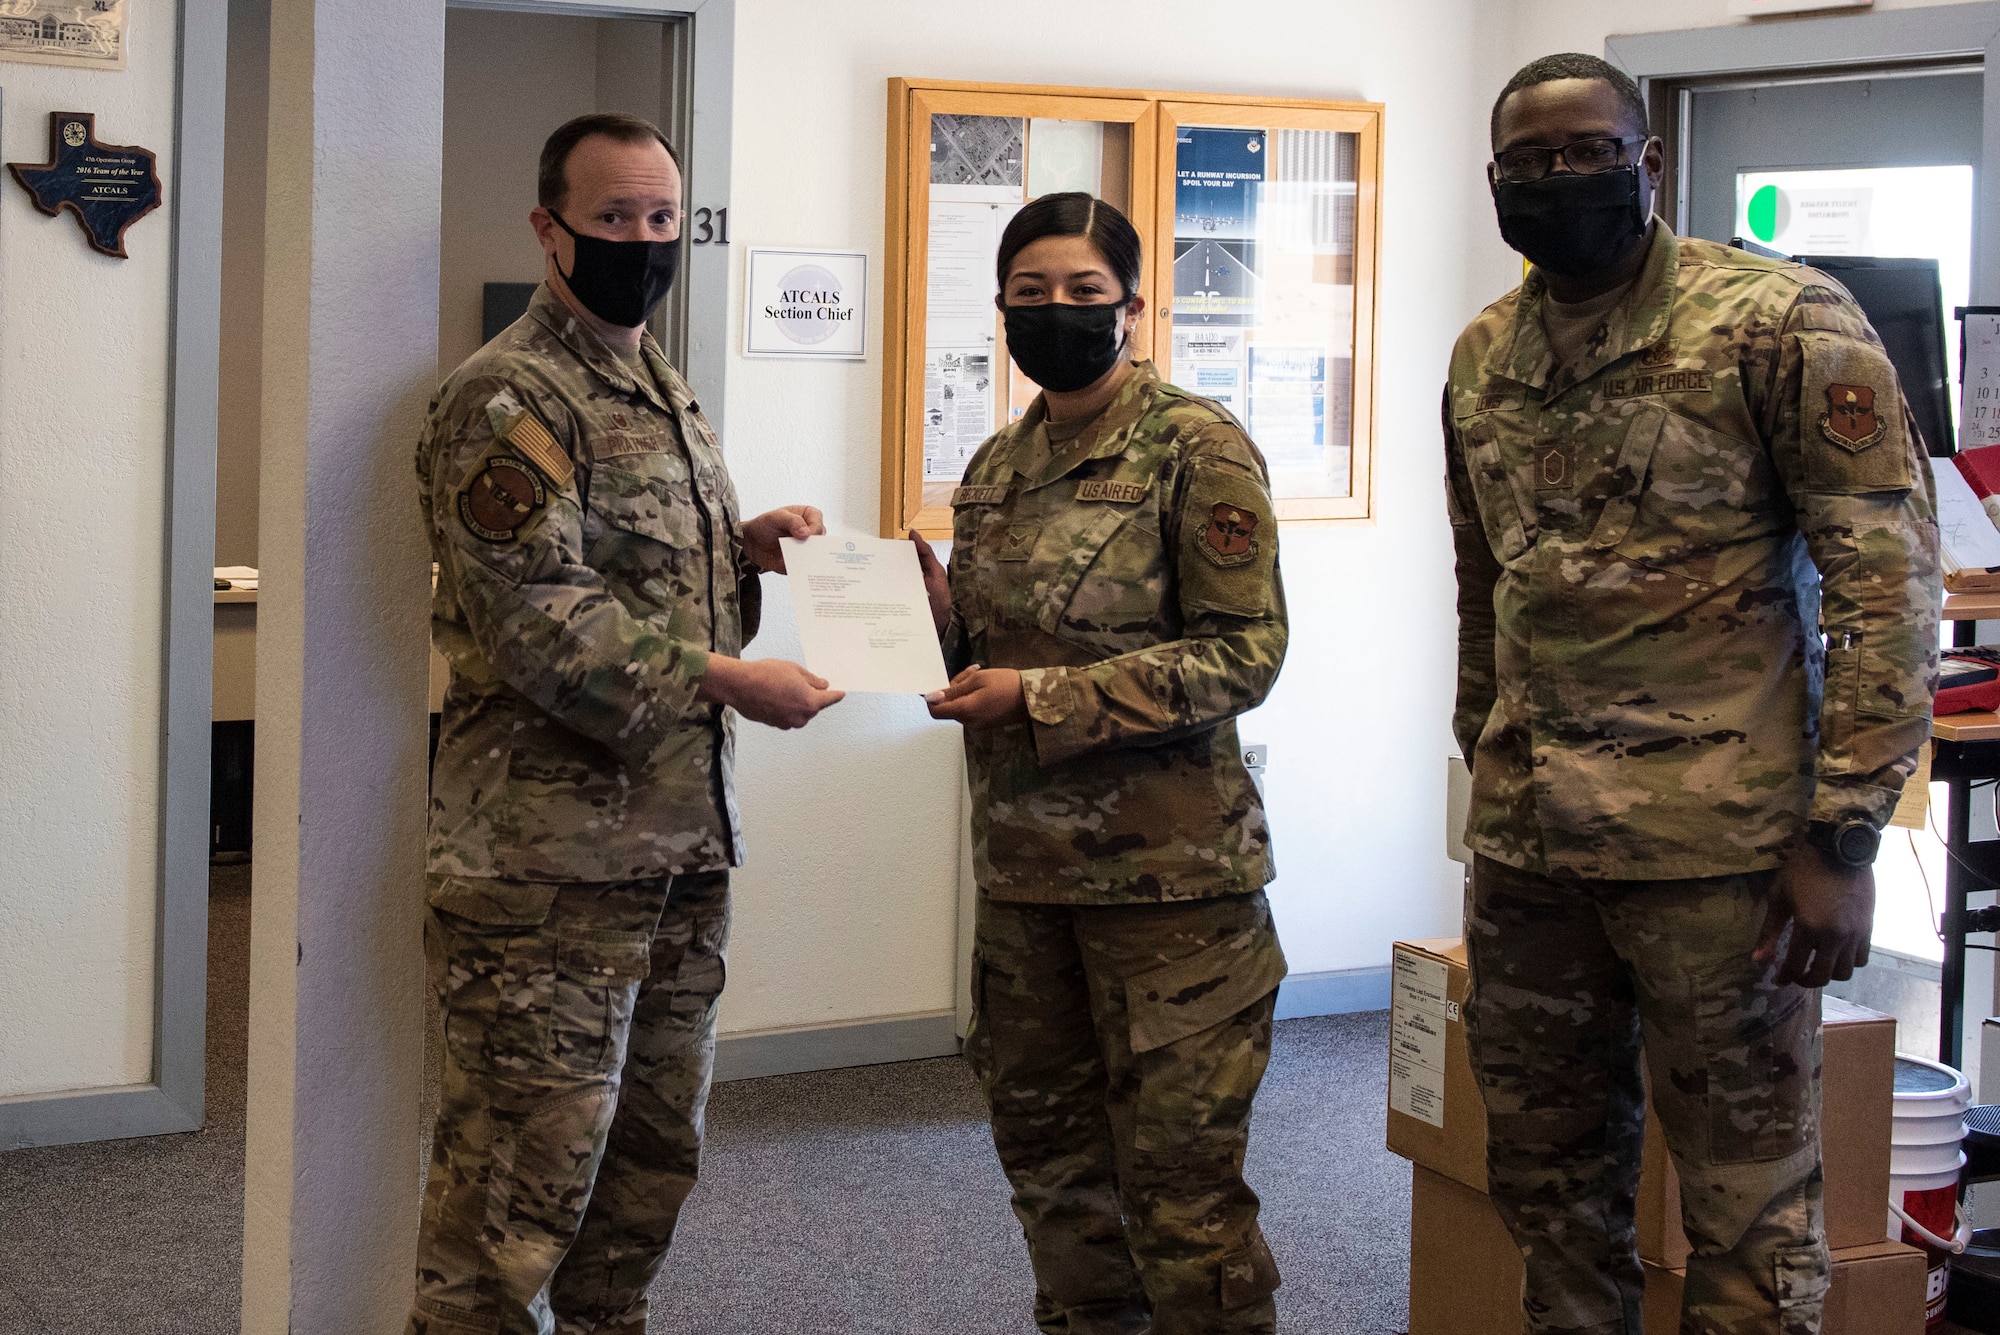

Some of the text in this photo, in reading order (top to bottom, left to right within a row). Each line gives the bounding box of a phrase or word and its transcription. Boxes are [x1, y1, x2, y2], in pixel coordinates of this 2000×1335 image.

[96, 156, 120, 164] Operations
[76, 166, 92, 174] 2016
[111, 168, 118, 176] of
[1197, 171, 1224, 179] RUNWAY
[1225, 172, 1261, 180] INCURSION
[92, 186, 128, 194] ATCALS
[693, 207, 730, 244] 31
[780, 290, 840, 304] ATCALS
[765, 305, 853, 320] Section Chief
[1981, 367, 1988, 379] 3
[1632, 376, 1653, 394] AIR
[1658, 371, 1708, 389] FORCE
[1977, 387, 1990, 399] 10
[1975, 406, 1988, 419] 17
[1101, 483, 1121, 499] AIR
